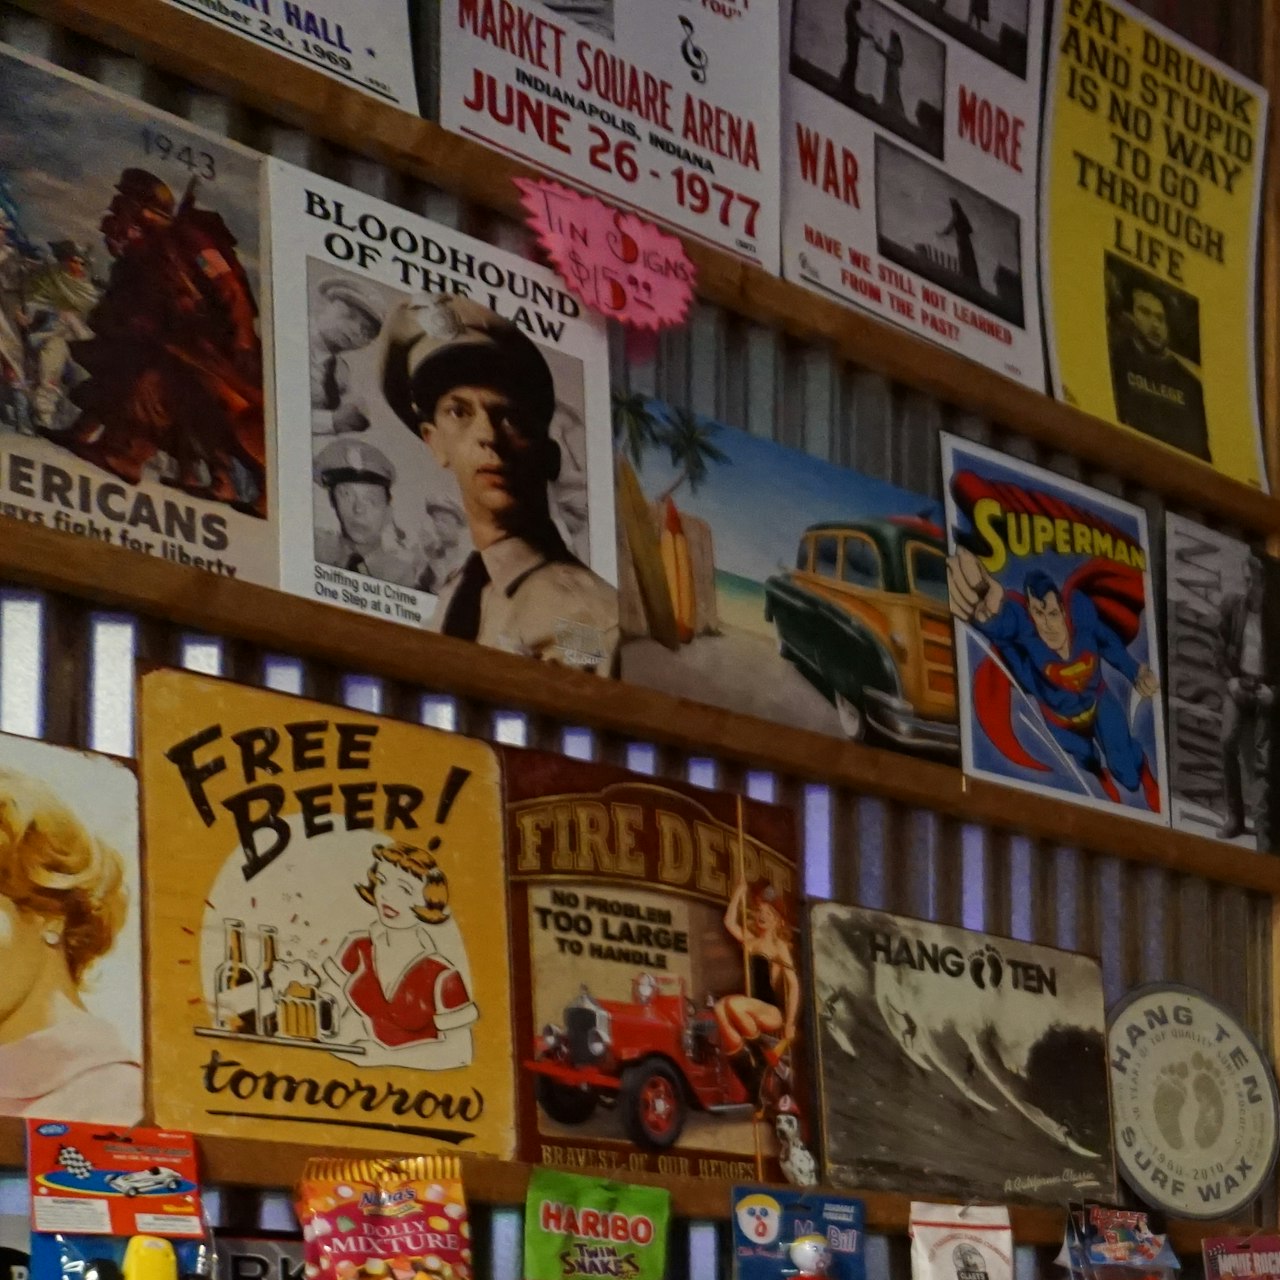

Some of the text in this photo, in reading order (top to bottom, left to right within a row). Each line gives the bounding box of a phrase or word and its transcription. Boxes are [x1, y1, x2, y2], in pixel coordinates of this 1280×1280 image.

[301, 39, 352, 70] 1969
[455, 0, 762, 173] MARKET SQUARE ARENA
[1142, 29, 1253, 125] DRUNK
[957, 84, 1025, 174] MORE
[1061, 25, 1253, 164] AND STUPID
[1067, 66, 1242, 195] IS NO WAY
[141, 127, 220, 182] 1943
[463, 68, 762, 239] JUNE 26 1977
[796, 121, 861, 209] WAR
[1110, 132, 1200, 210] TO GO
[538, 186, 692, 284] TIN SIGNS
[1073, 150, 1225, 265] THROUGH
[302, 188, 582, 320] BLOODHOUND
[324, 231, 384, 279] OF
[1114, 217, 1185, 283] LIFE
[971, 497, 1148, 574] SUPERMAN
[313, 582, 339, 601] One
[164, 720, 381, 828] FREE
[223, 767, 472, 881] BEER!
[517, 802, 646, 885] FIRE
[533, 904, 690, 955] TOO LARGE
[549, 888, 673, 926] NO PROBLEM
[556, 935, 669, 971] TO HANDLE
[869, 933, 1058, 998] HANG TEN
[201, 1050, 486, 1126] tomorrow
[1112, 1003, 1265, 1107] HANG TEN
[540, 1144, 618, 1169] BRAVEST
[658, 1155, 689, 1177] OUR
[1118, 1125, 1255, 1203] SURF WAX
[329, 1230, 459, 1256] MIXTURE
[361, 1220, 427, 1236] DOLLY
[541, 1200, 654, 1240] HARIBO
